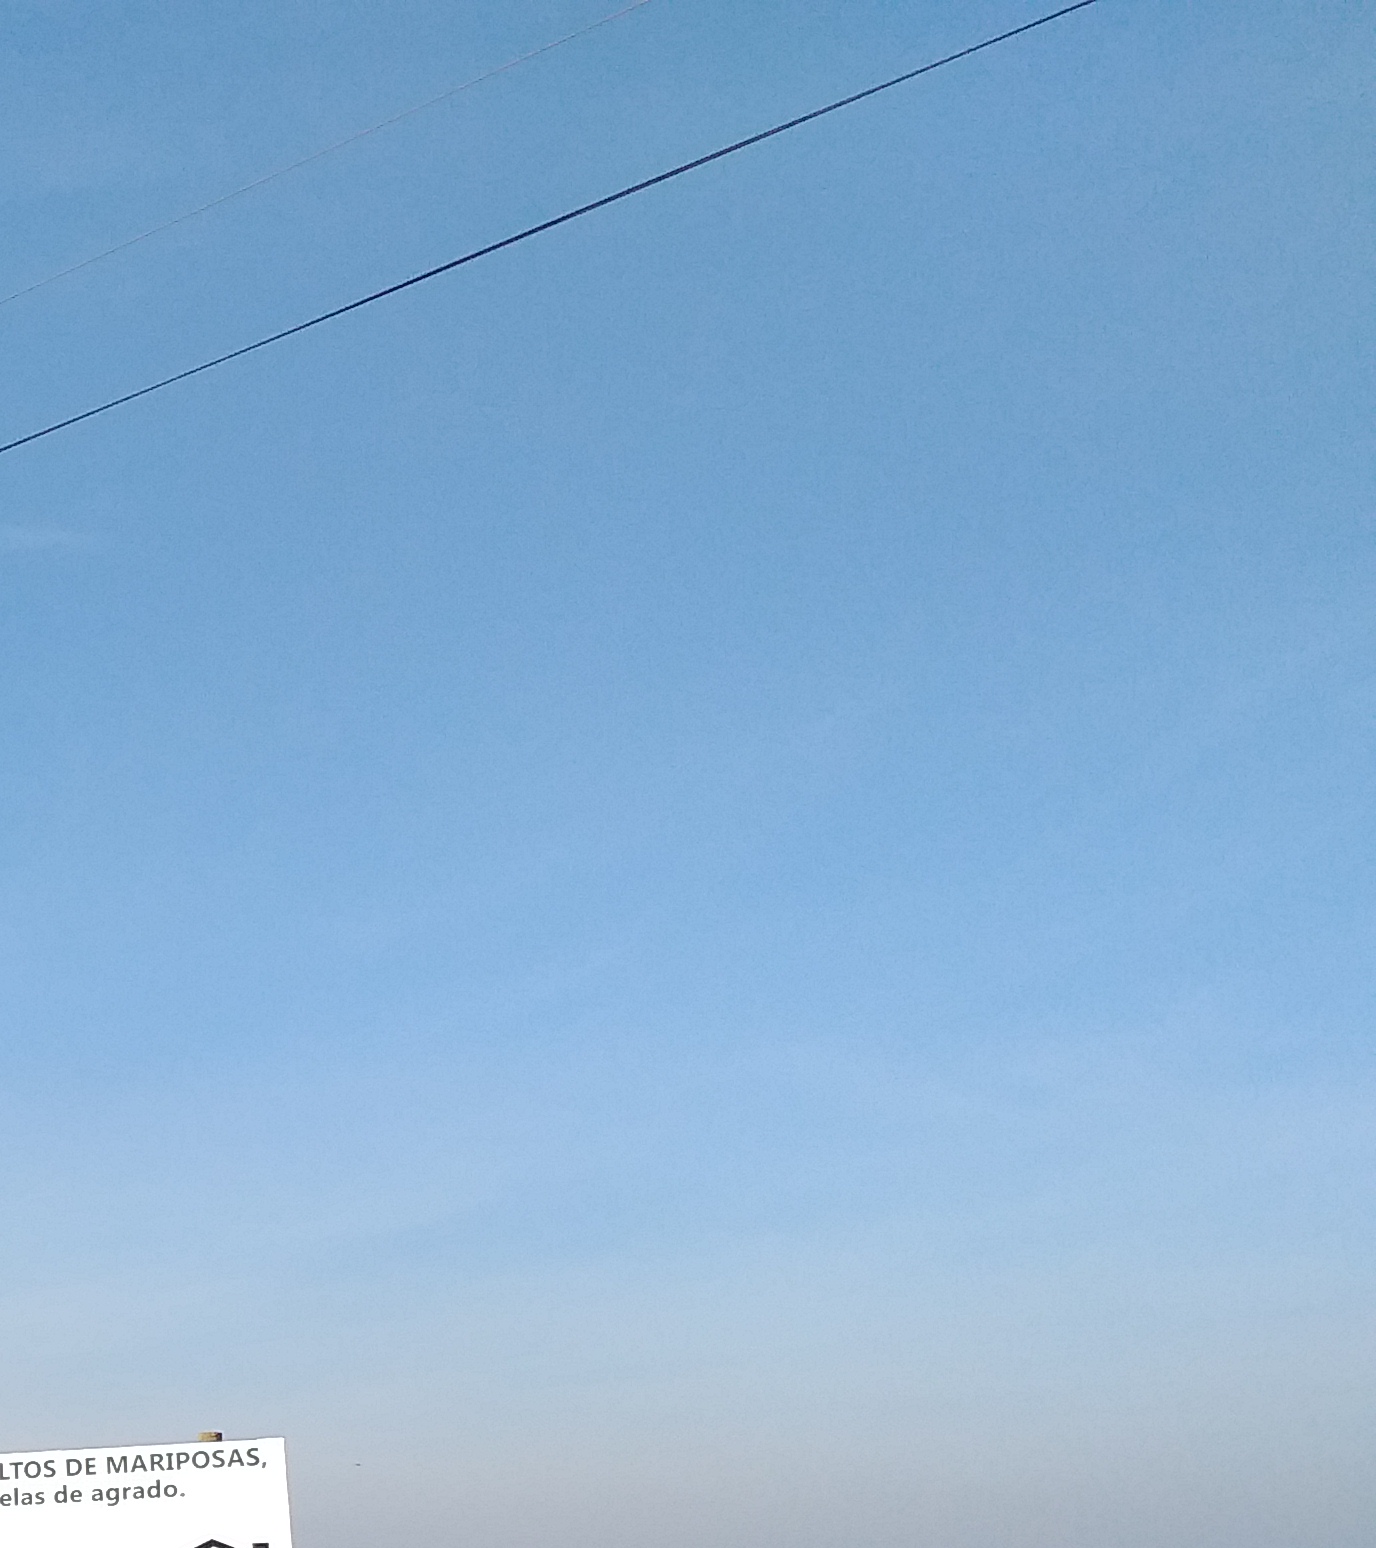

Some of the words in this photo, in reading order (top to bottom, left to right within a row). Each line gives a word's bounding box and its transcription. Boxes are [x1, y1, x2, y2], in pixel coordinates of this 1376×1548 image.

[66, 1457, 97, 1477] DE
[107, 1447, 267, 1475] MARIPOSAS,
[54, 1485, 83, 1504] de
[91, 1479, 186, 1506] agrado.
